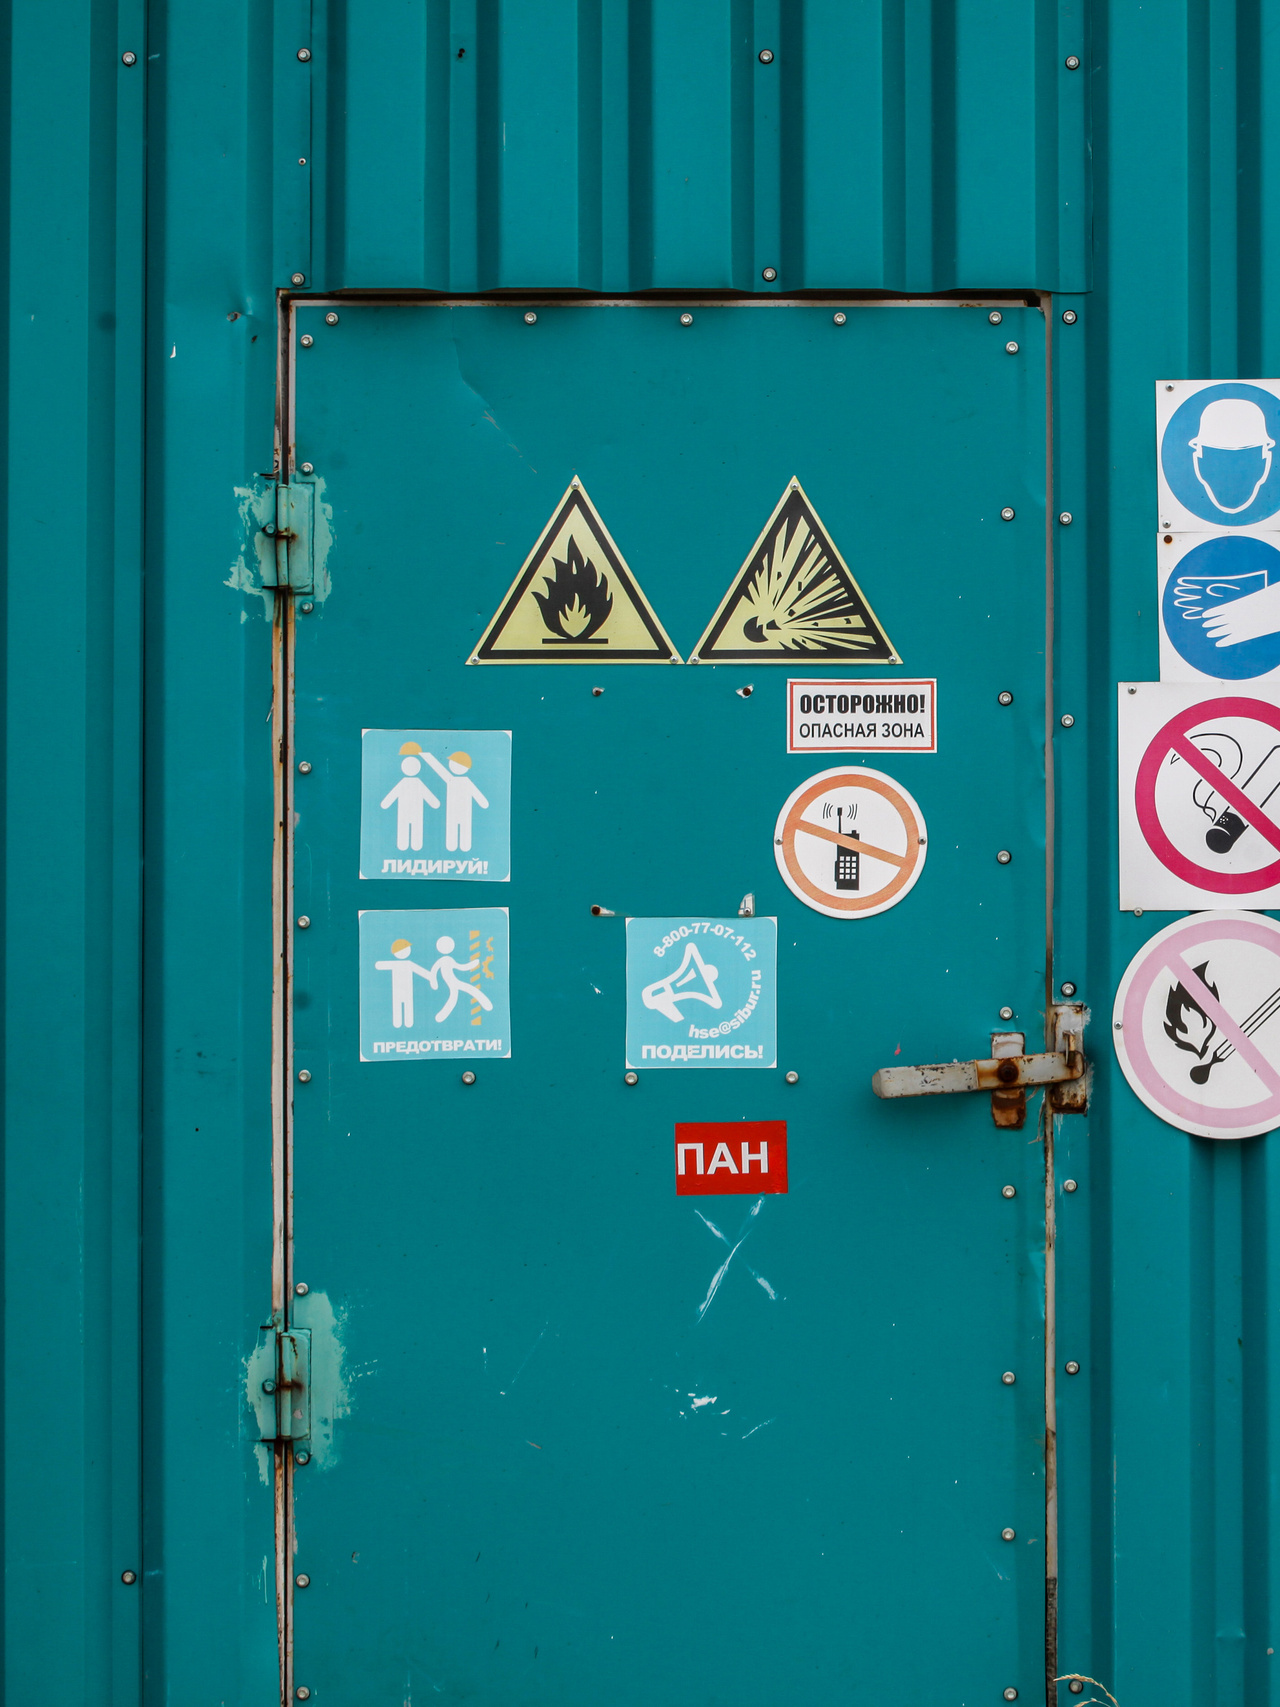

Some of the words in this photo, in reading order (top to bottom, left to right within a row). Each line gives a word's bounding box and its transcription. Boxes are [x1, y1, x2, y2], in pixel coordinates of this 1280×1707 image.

[800, 694, 926, 714] ОСТОРОЖНО!
[799, 723, 877, 738] ОПАСНАЯ
[881, 722, 925, 738] ЗОНА
[381, 857, 489, 876] ЛИДИРУЙ!
[653, 922, 757, 962] 8-800-77-07-112
[688, 969, 762, 1039] hse@sibur.ru
[373, 1039, 503, 1055] ПРЕДОТВРАТИ!
[641, 1045, 764, 1062] ПОДЕЛИСЬ!
[677, 1141, 769, 1175] ПАН
